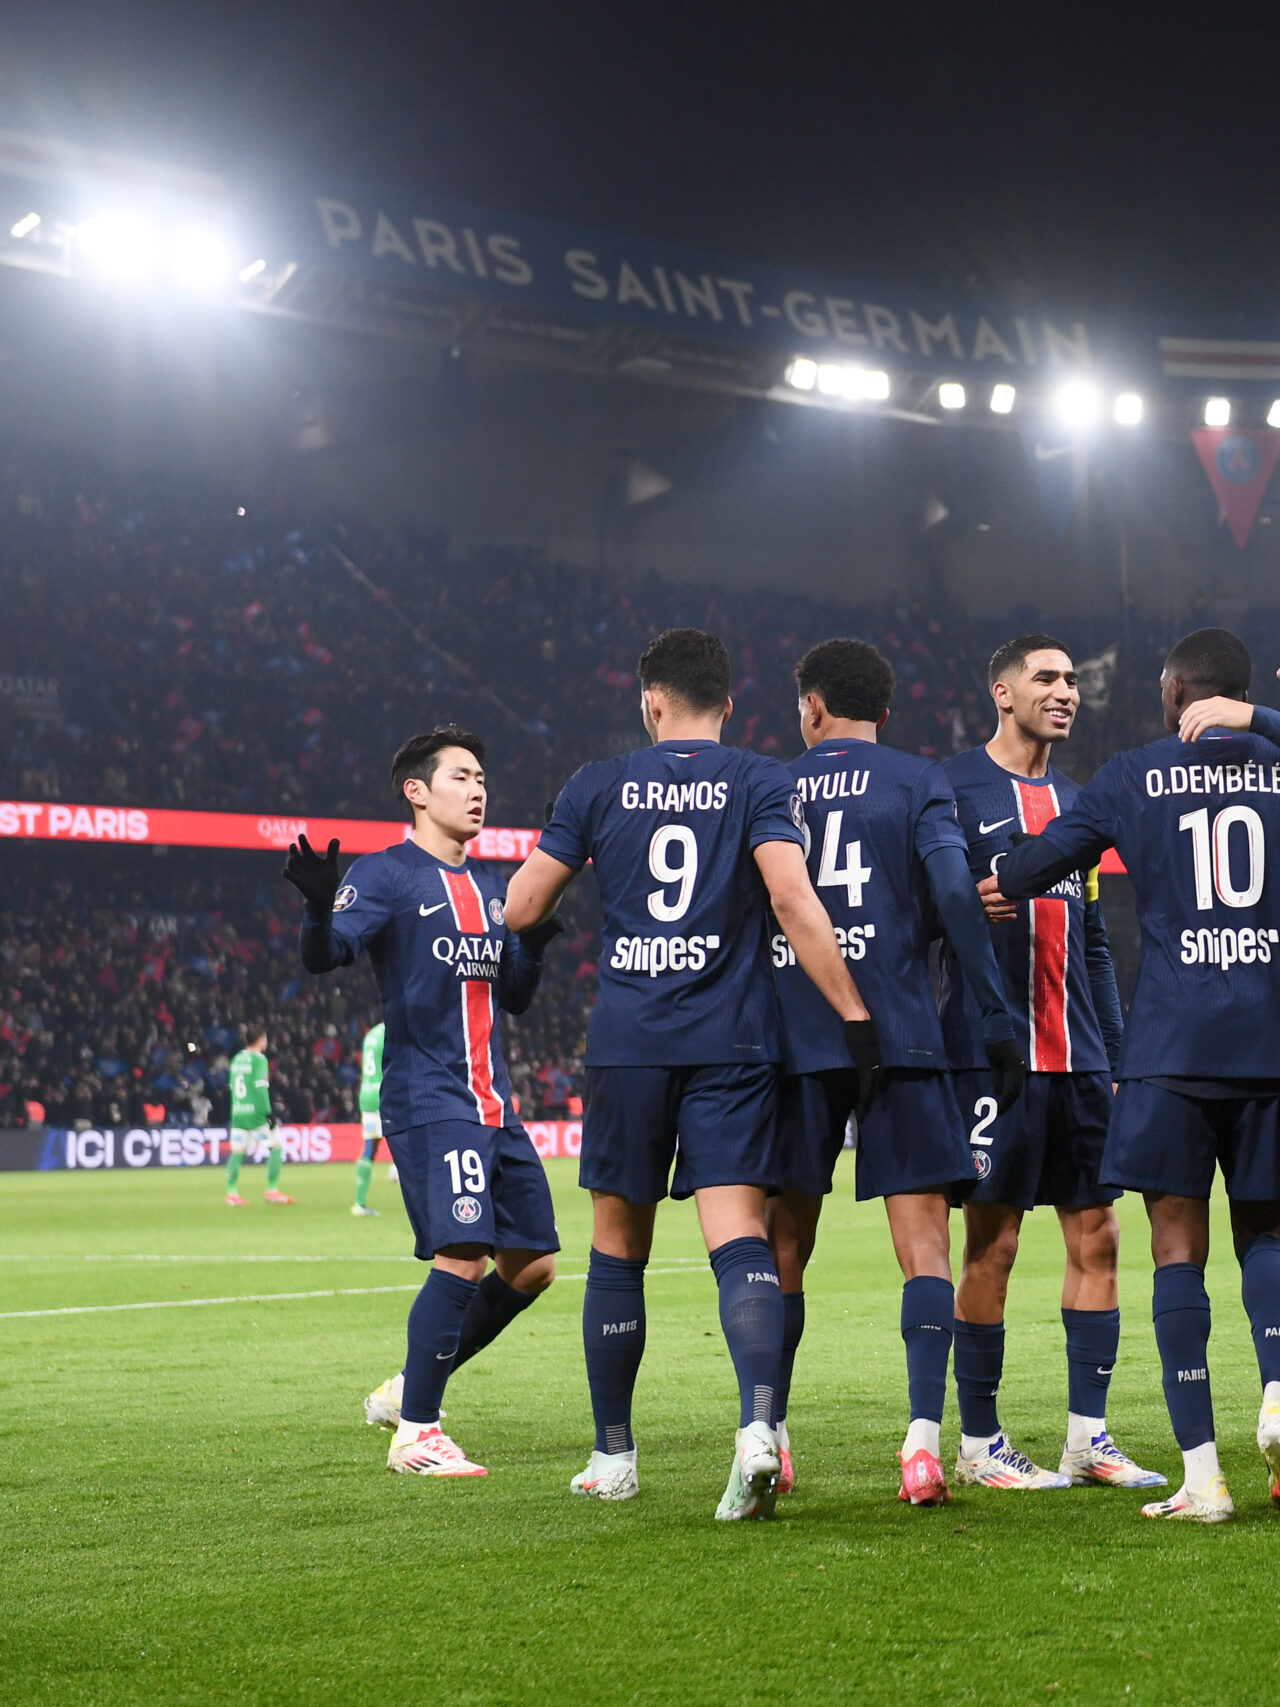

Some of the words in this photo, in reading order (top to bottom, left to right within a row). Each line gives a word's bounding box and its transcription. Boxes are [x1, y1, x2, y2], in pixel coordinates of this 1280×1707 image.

[317, 198, 533, 286] PARIS
[564, 248, 1092, 367] SAINT-GERMAIN
[621, 780, 728, 813] G.RAMOS
[49, 804, 149, 841] PARIS
[258, 818, 307, 840] QATAR
[646, 824, 698, 922] 9
[803, 810, 872, 907] 4
[1178, 804, 1265, 910] 10
[432, 936, 503, 966] QATAR
[610, 934, 708, 978] snipes
[1180, 927, 1272, 970] snipes
[234, 1073, 247, 1099] 6
[969, 1096, 998, 1146] 2
[66, 1130, 114, 1168] ICI
[123, 1128, 228, 1167] C'EST
[443, 1149, 486, 1194] 19
[747, 1271, 779, 1287] PARIS
[602, 1319, 638, 1336] PARIS
[1177, 1368, 1206, 1382] PARIS
